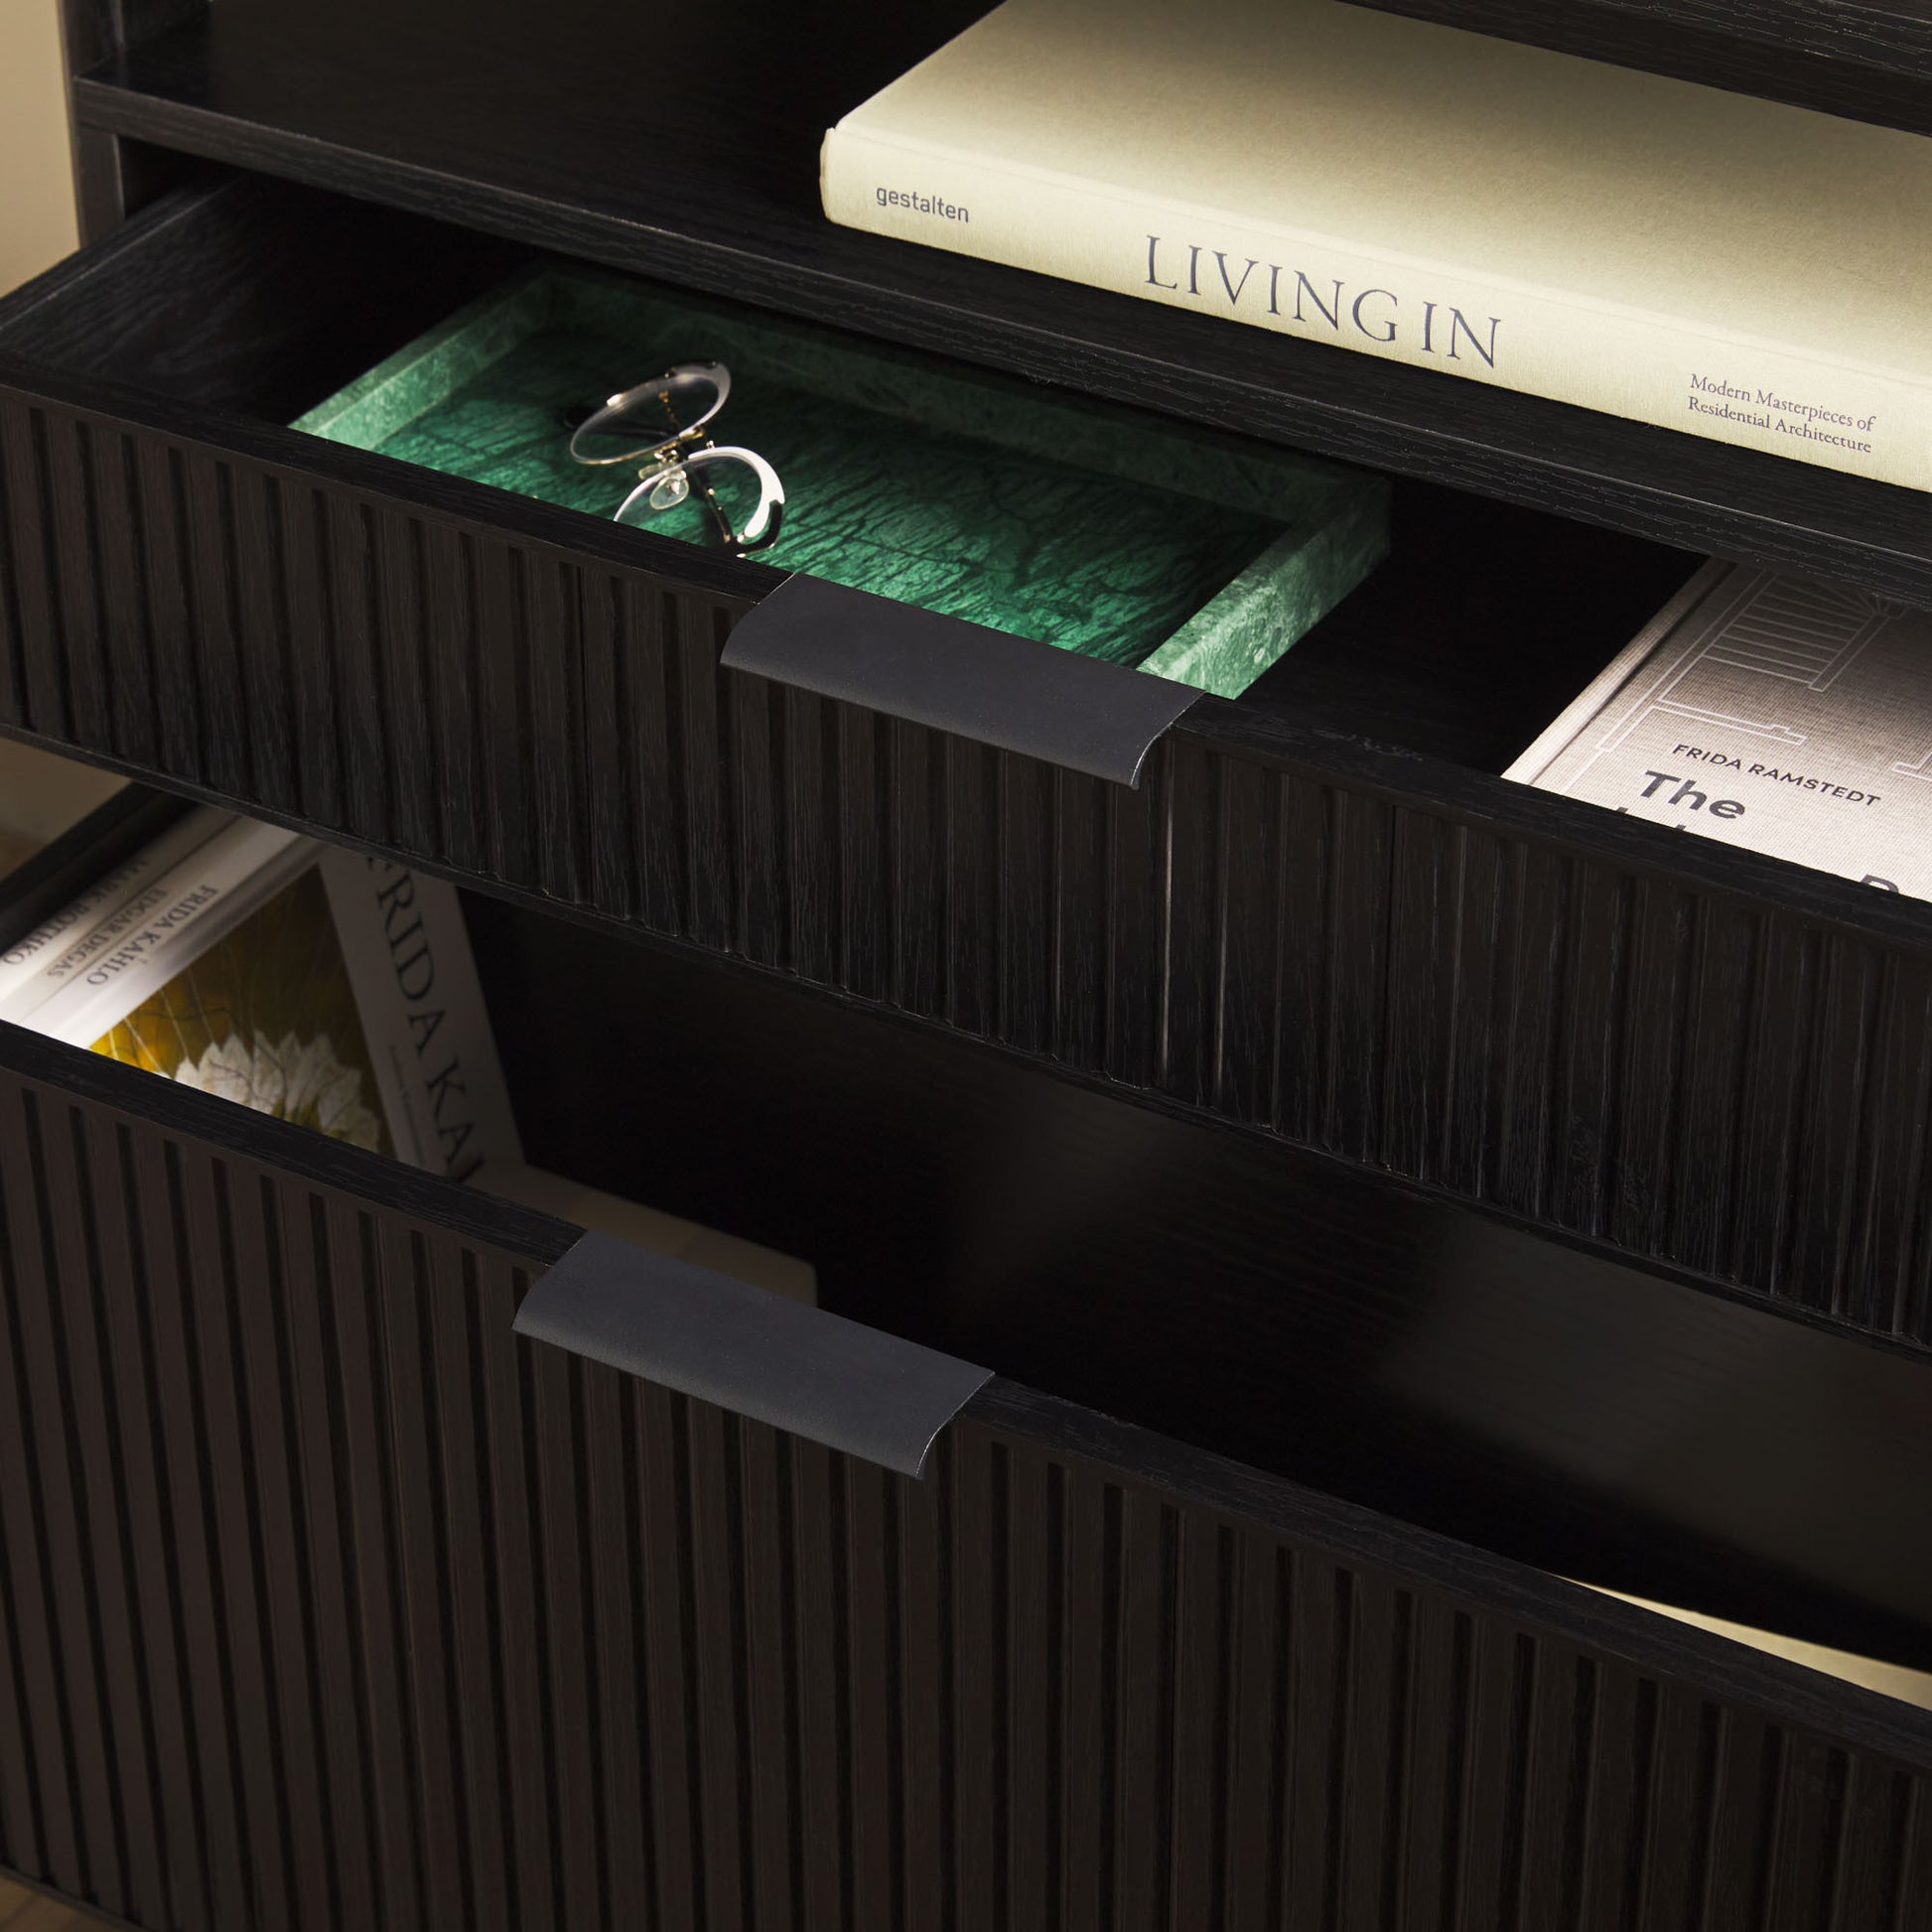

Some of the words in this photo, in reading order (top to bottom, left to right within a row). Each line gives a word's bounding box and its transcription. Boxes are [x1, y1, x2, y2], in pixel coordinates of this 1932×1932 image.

[876, 185, 970, 224] gestalten
[1145, 233, 1399, 343] LIVING
[1421, 300, 1502, 369] IN
[1687, 395, 1771, 430] Residential
[1774, 418, 1872, 454] Architecture
[1690, 372, 1751, 402] Modern
[1754, 388, 1854, 428] Masterpieces
[1856, 415, 1877, 433] of
[1639, 768, 1746, 820] The
[1671, 743, 1742, 771] FRIDA
[1746, 762, 1882, 807] RAMSTEDT
[109, 887, 169, 935] EDGAR
[153, 884, 219, 931] FRIDA
[47, 933, 109, 979] DEGAS
[86, 930, 162, 987] KAHLO
[365, 856, 446, 1058] RIDA
